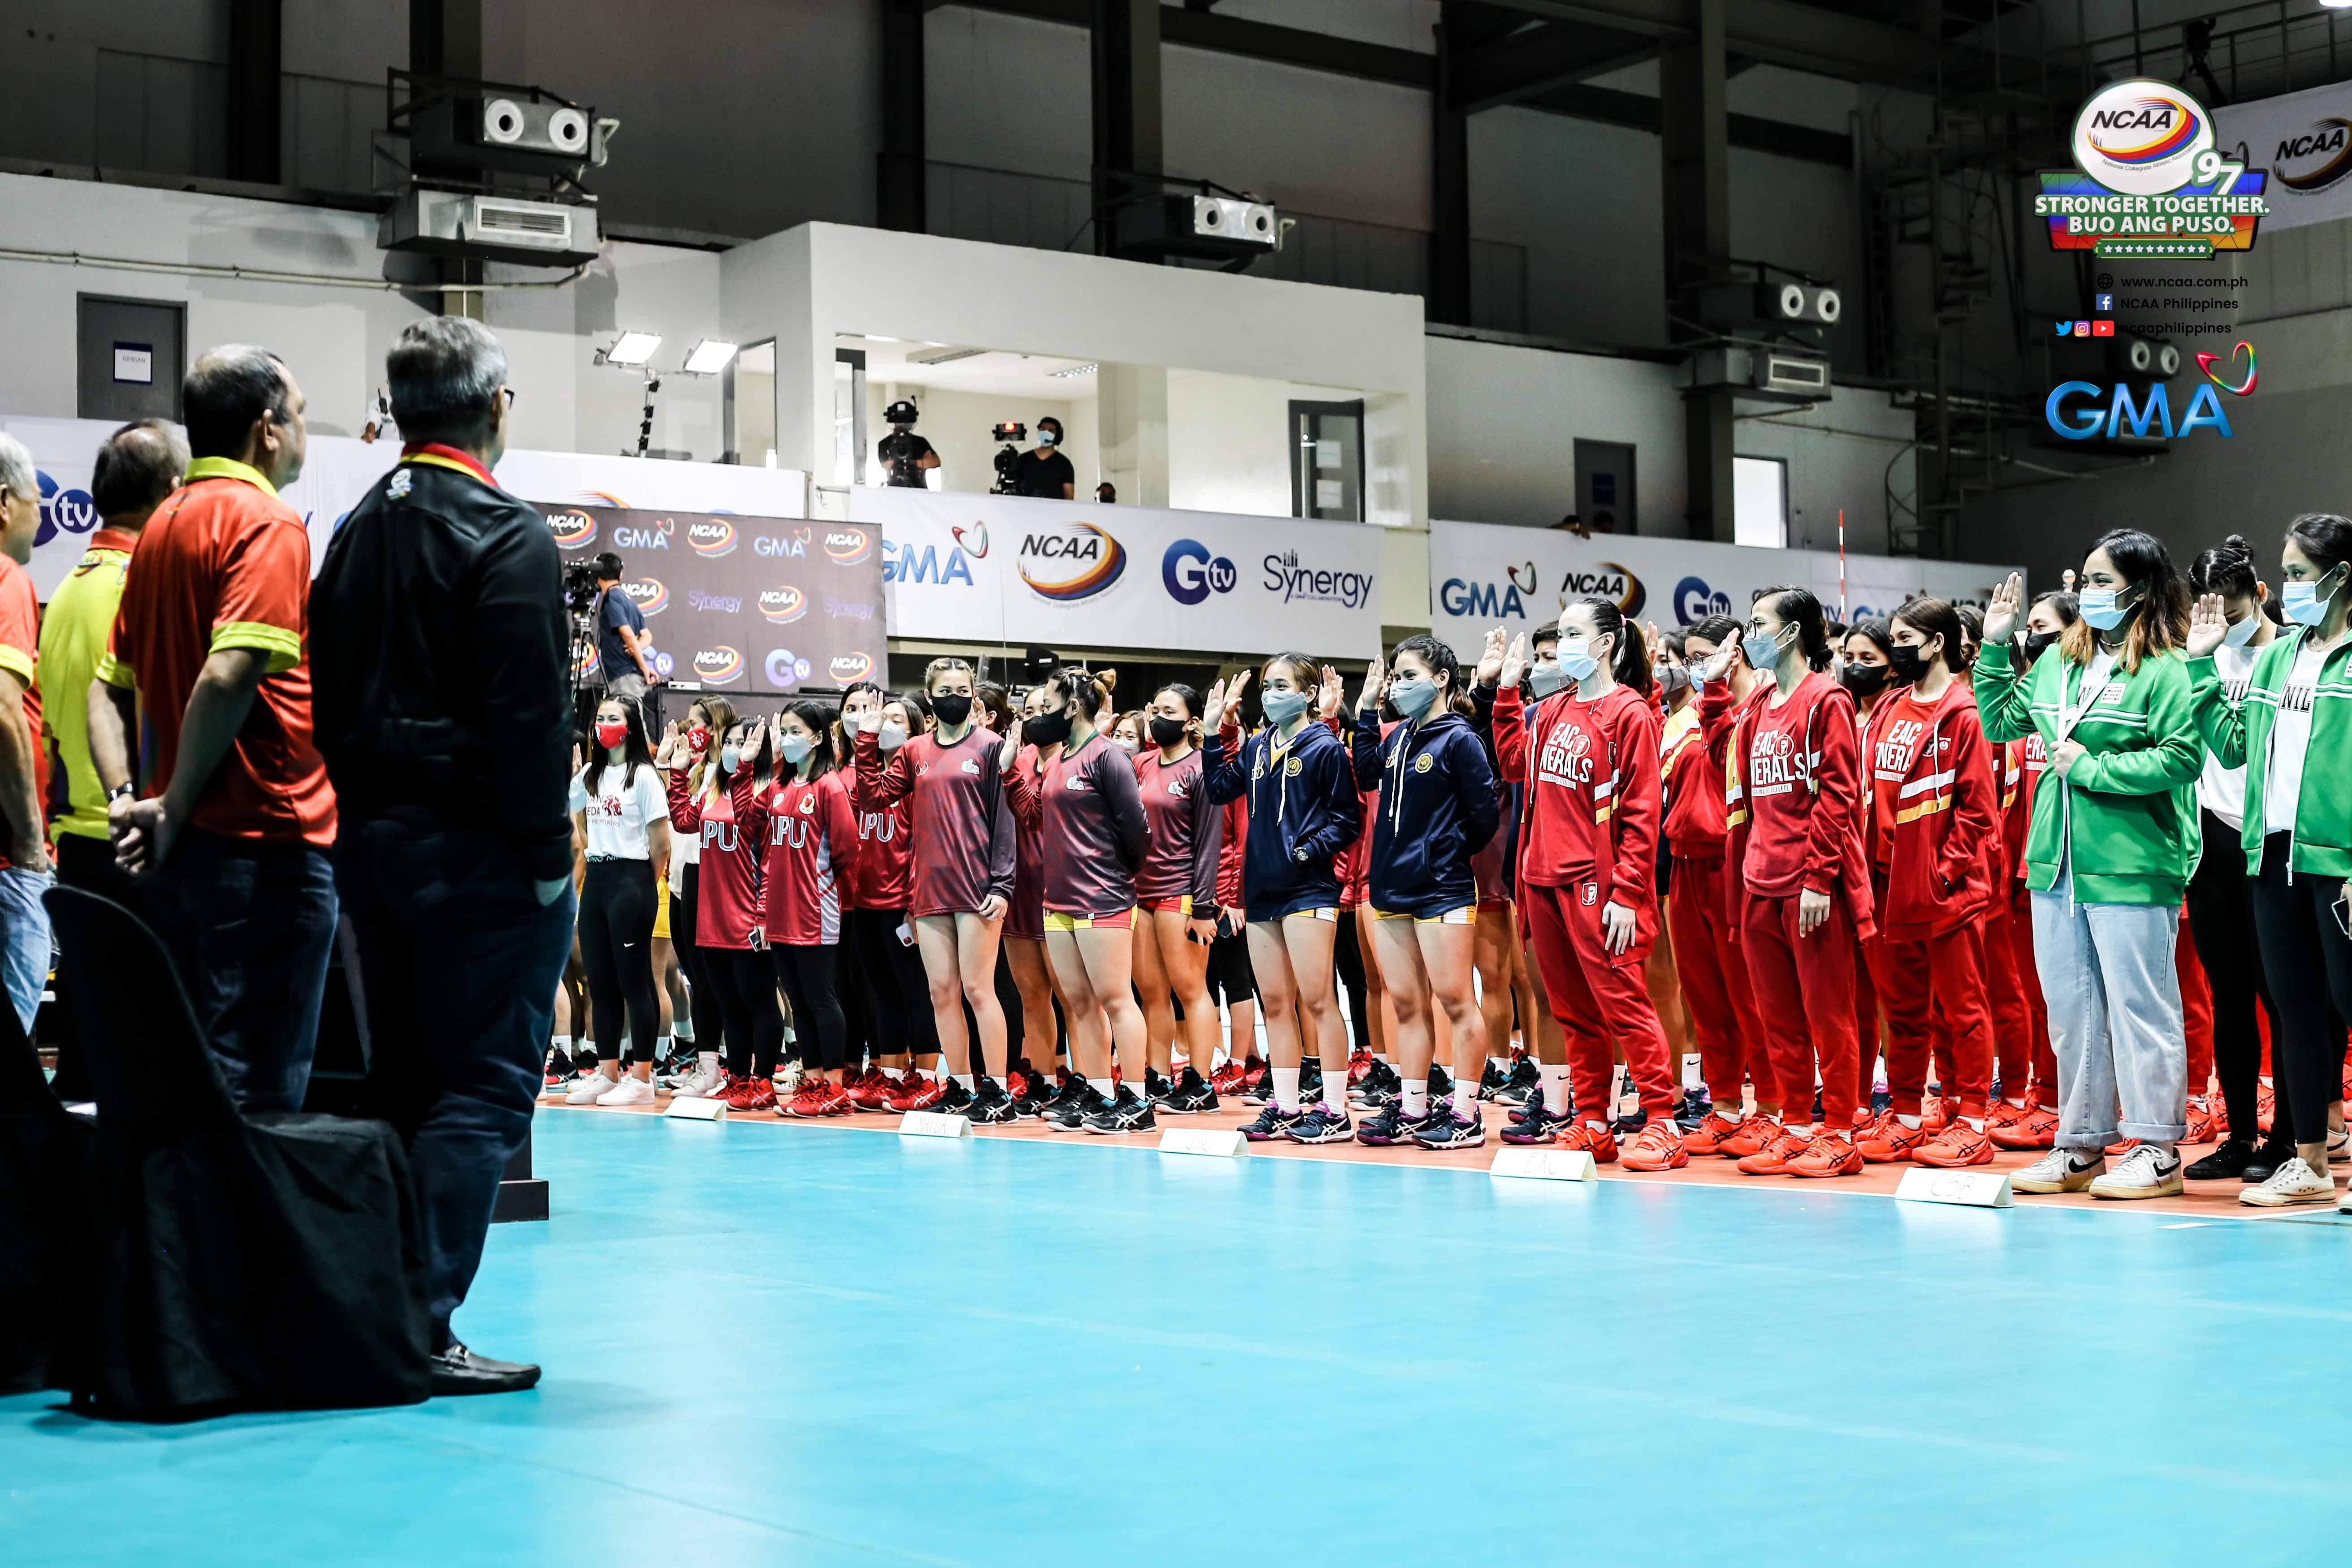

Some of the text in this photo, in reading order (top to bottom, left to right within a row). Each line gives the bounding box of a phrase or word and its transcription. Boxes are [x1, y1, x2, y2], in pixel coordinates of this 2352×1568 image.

[2275, 129, 2344, 161] NCAA
[546, 514, 585, 529] NCAA
[688, 523, 727, 538] NCAA
[613, 527, 669, 550] GMA
[753, 536, 806, 558] GMA
[825, 533, 862, 546] NCAA
[1020, 534, 1098, 560] NCAA
[1263, 554, 1373, 609] Synergy
[1561, 572, 1625, 596] NCAA
[688, 589, 743, 613] Synergy
[759, 591, 797, 605] NCAA
[823, 597, 876, 620] Synergy
[1440, 577, 1526, 619] GMA
[694, 651, 734, 665] NCAA
[830, 656, 867, 670] NCAA
[1548, 722, 1581, 750] EAC
[1751, 729, 1779, 757] EAC
[1886, 719, 1923, 746] EAC
[1539, 744, 1594, 783] NERALS
[1771, 785, 1790, 793] COLLEGE
[587, 806, 601, 816] EDA
[860, 810, 894, 842] LPU
